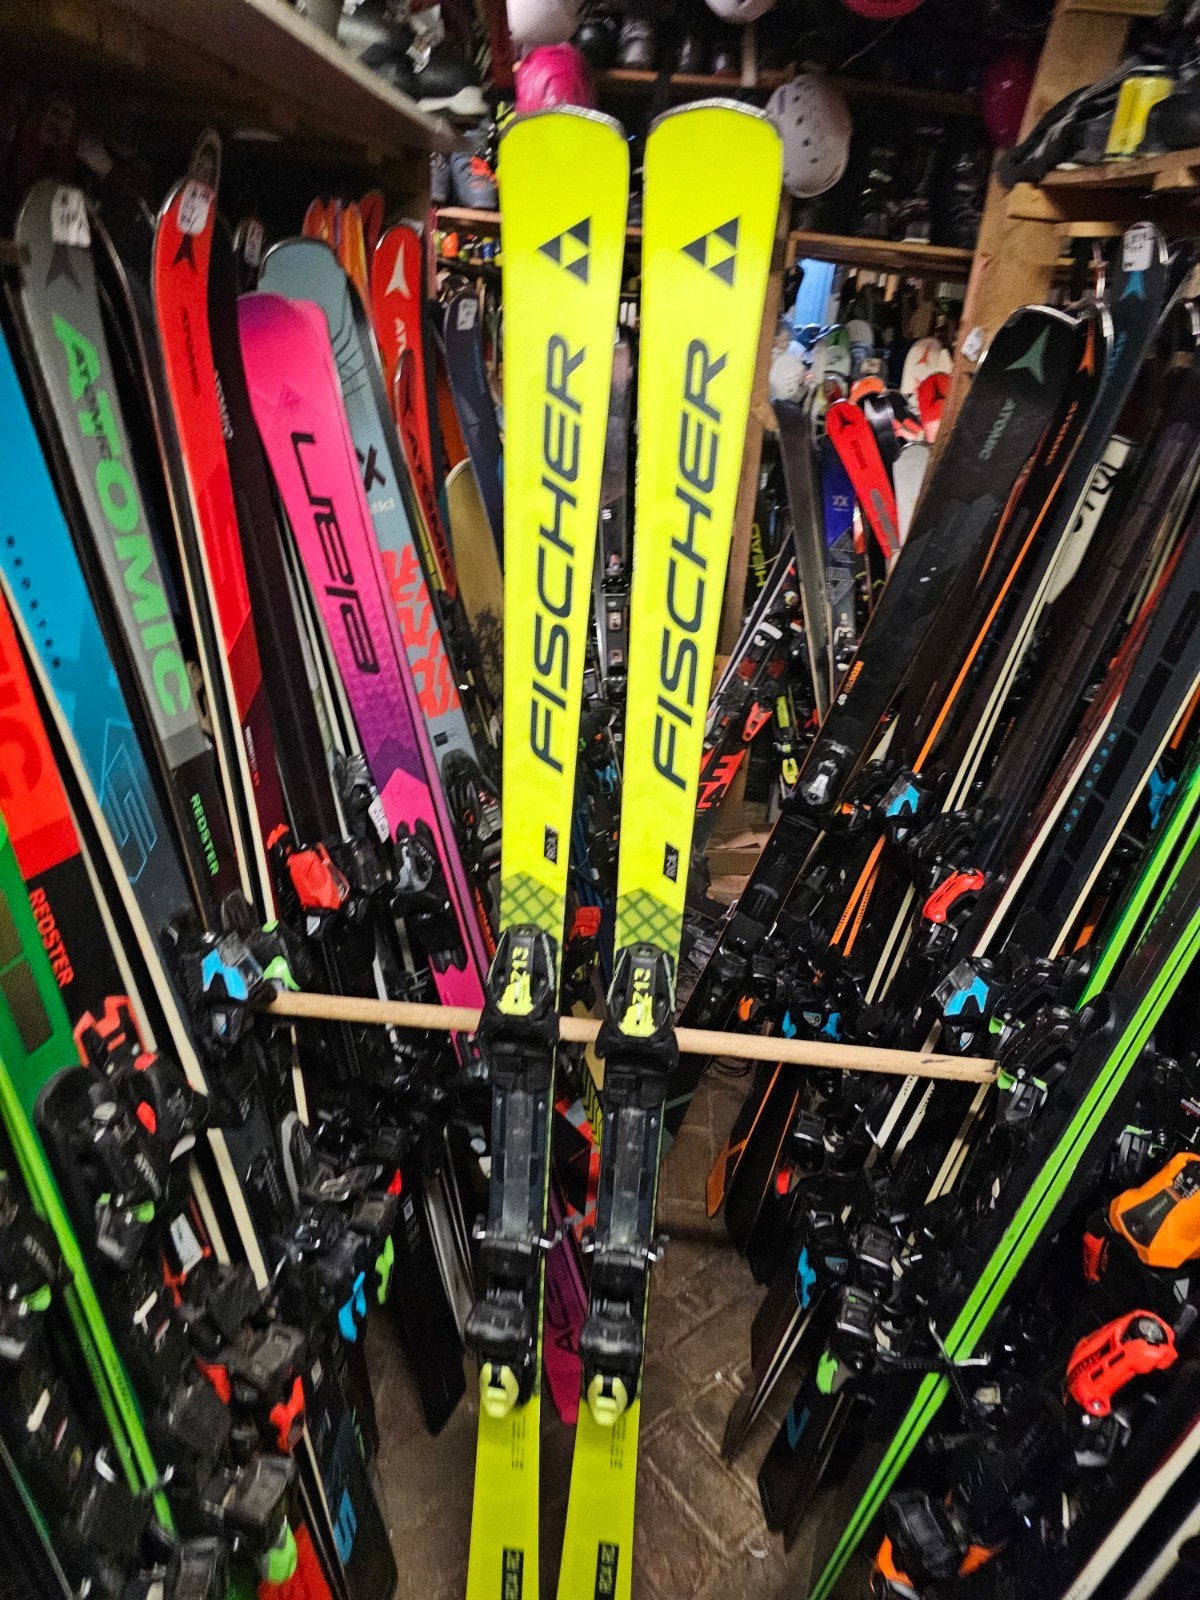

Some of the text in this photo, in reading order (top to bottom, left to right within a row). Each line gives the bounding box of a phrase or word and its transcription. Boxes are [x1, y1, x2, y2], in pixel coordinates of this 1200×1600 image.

[52, 315, 191, 717] ATOMIC
[291, 432, 380, 675] elan
[530, 334, 586, 774] FISCHER
[654, 339, 728, 791] FISCHER
[29, 888, 74, 988] REDSTER
[191, 793, 219, 876] REDSTER
